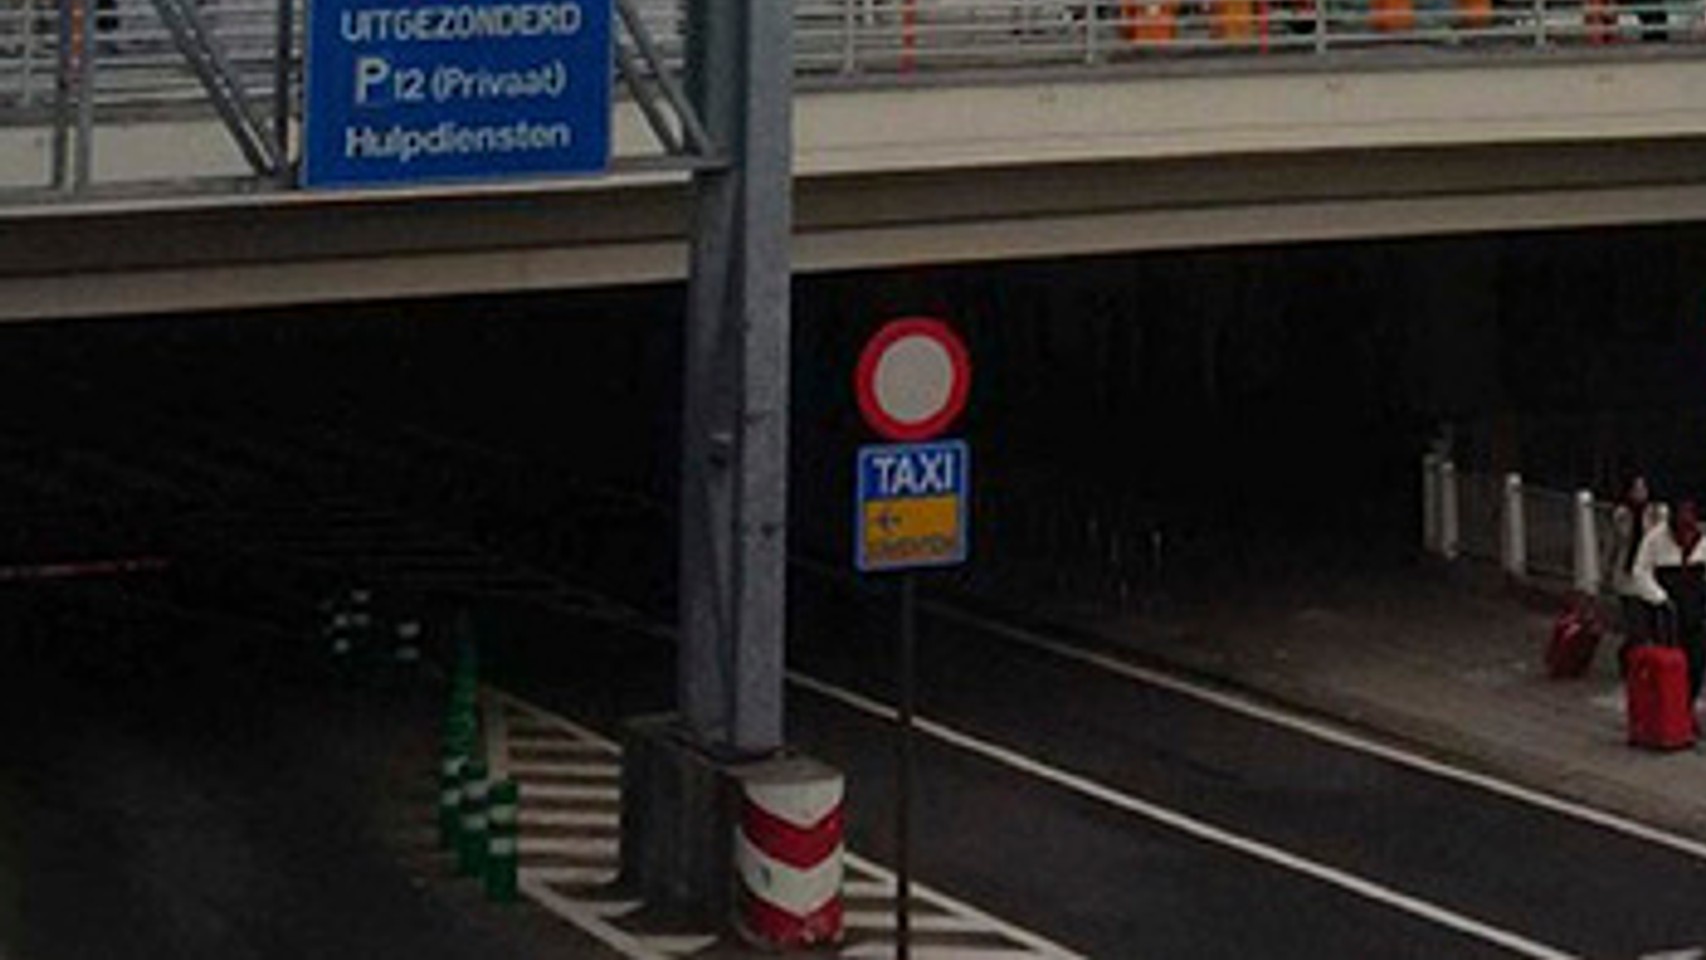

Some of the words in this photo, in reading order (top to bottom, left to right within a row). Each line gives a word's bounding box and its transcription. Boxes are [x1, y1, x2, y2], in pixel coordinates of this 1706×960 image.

[340, 2, 582, 42] UITGEZONDERD
[431, 59, 567, 103] (Privaat)
[344, 120, 572, 163] Hulpdiensten
[872, 451, 955, 496] TAXI
